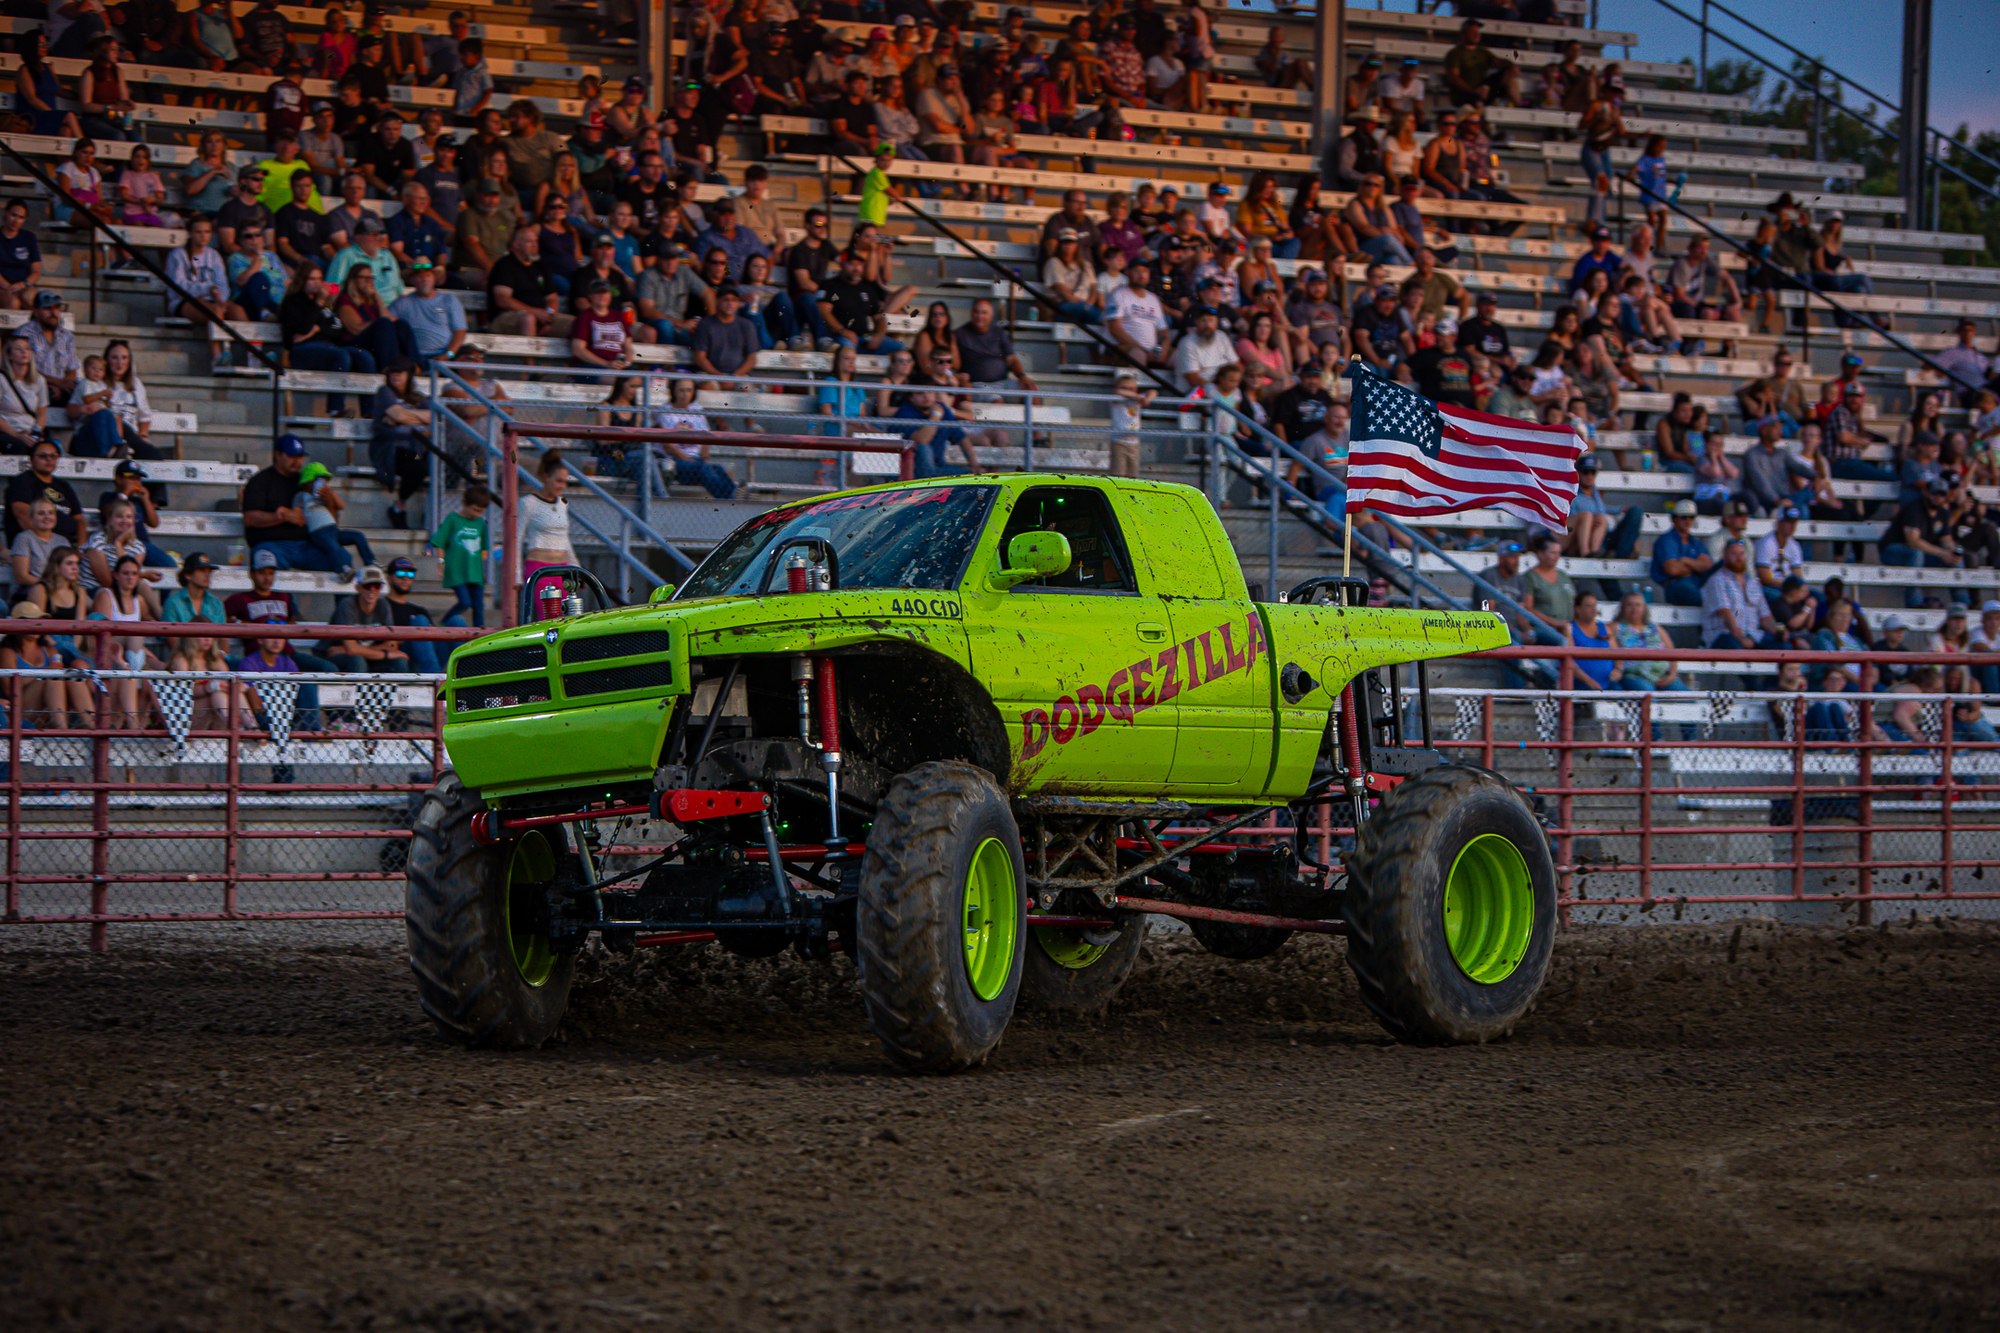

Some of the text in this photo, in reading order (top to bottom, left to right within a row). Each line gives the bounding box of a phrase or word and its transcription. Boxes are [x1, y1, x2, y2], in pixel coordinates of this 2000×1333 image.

[892, 598, 960, 617] 440 CID
[1423, 618, 1461, 629] AMERICAN
[1018, 611, 1269, 763] DODGEZILLA
